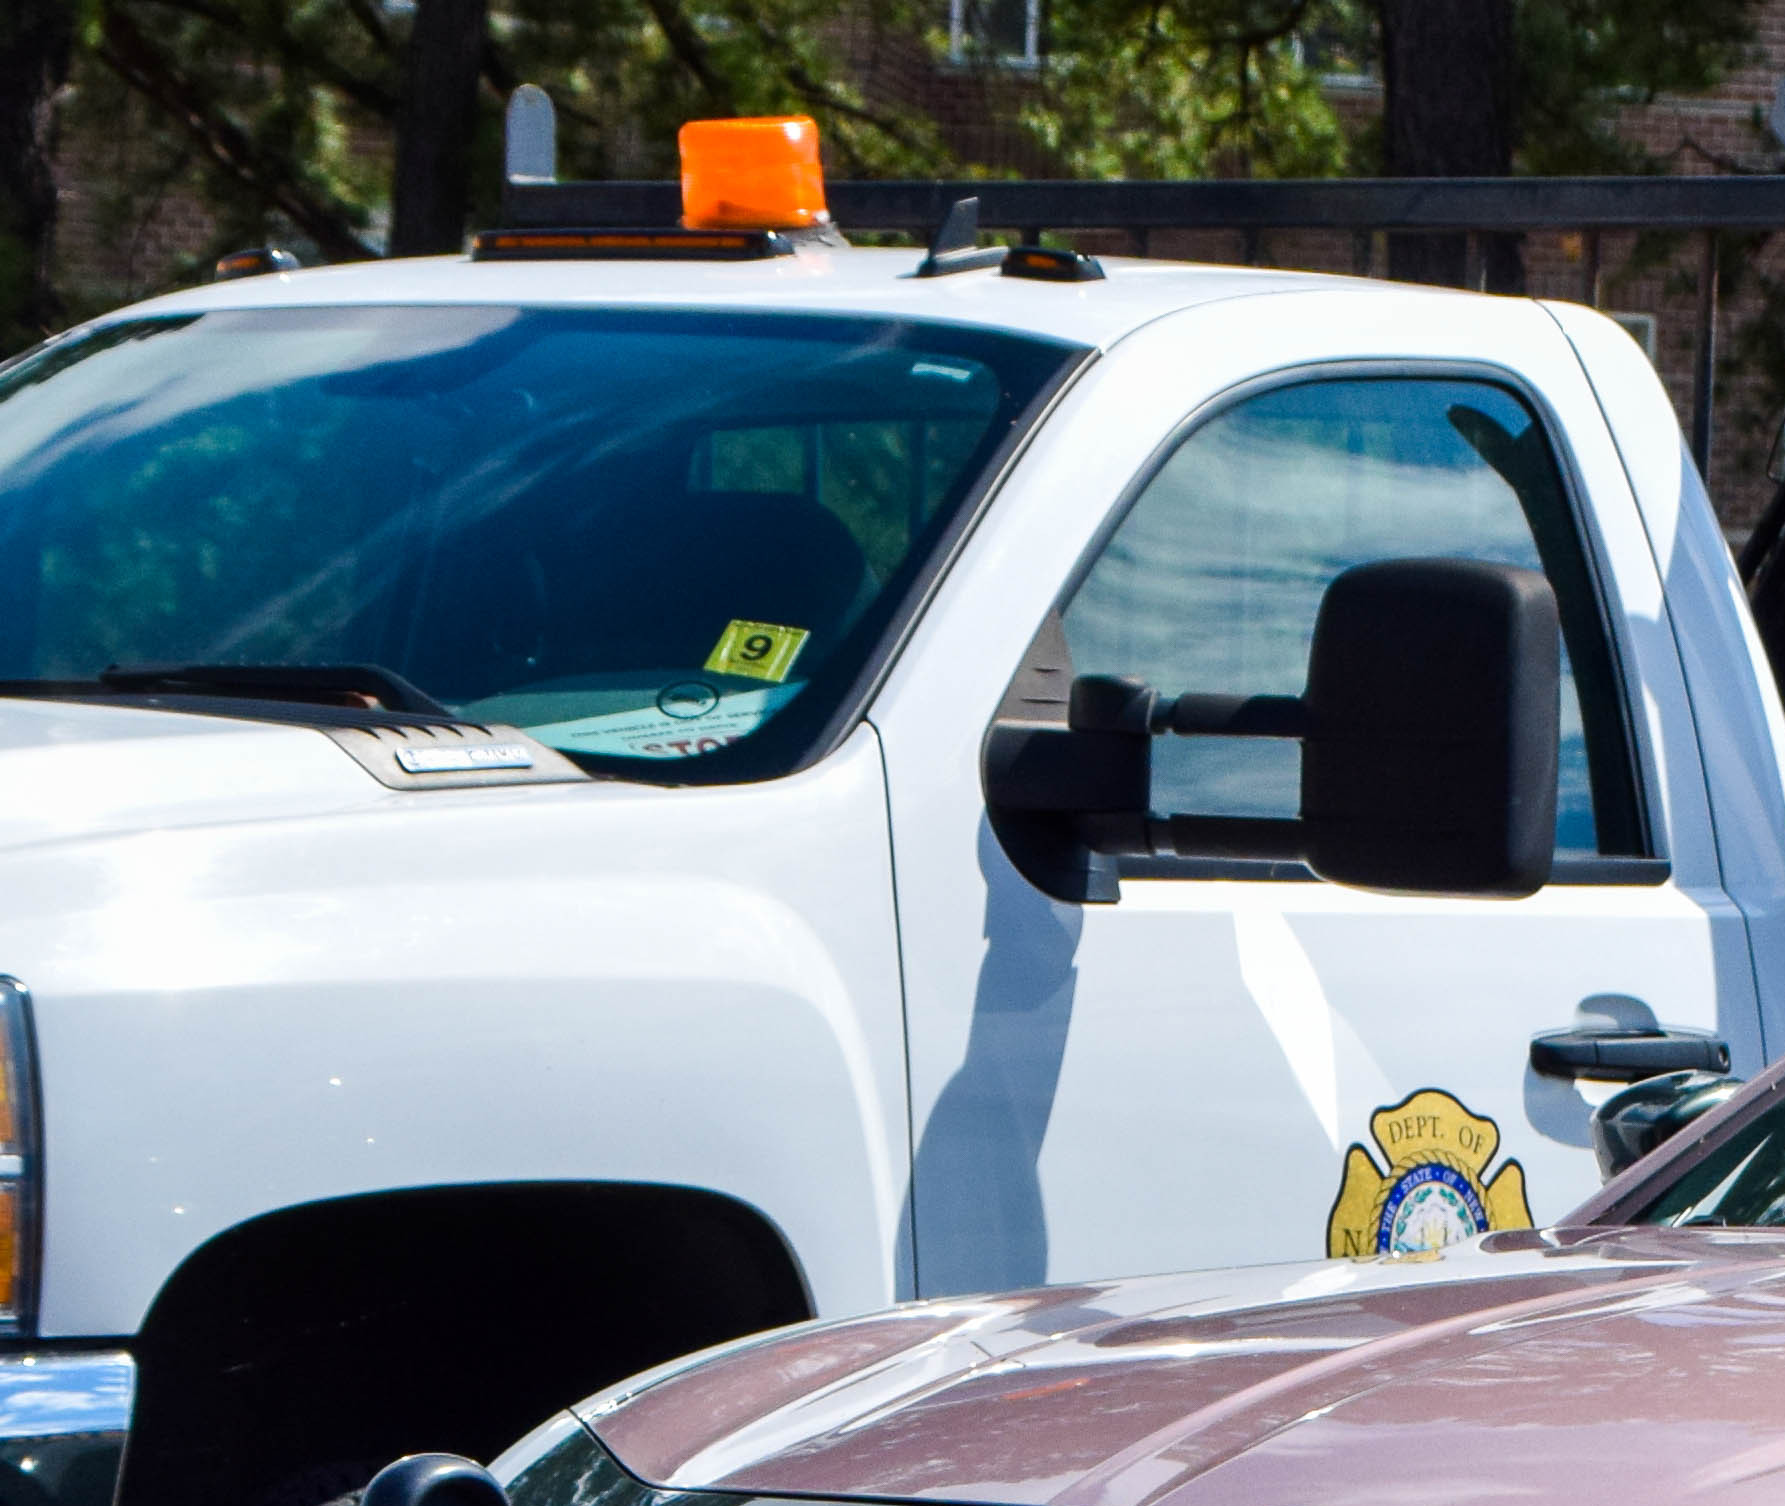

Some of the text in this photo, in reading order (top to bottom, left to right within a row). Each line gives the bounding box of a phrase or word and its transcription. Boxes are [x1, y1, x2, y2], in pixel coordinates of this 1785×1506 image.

[741, 634, 774, 660] 9
[1389, 1115, 1488, 1154] DEPT. OF
[1401, 1167, 1433, 1194] STATE
